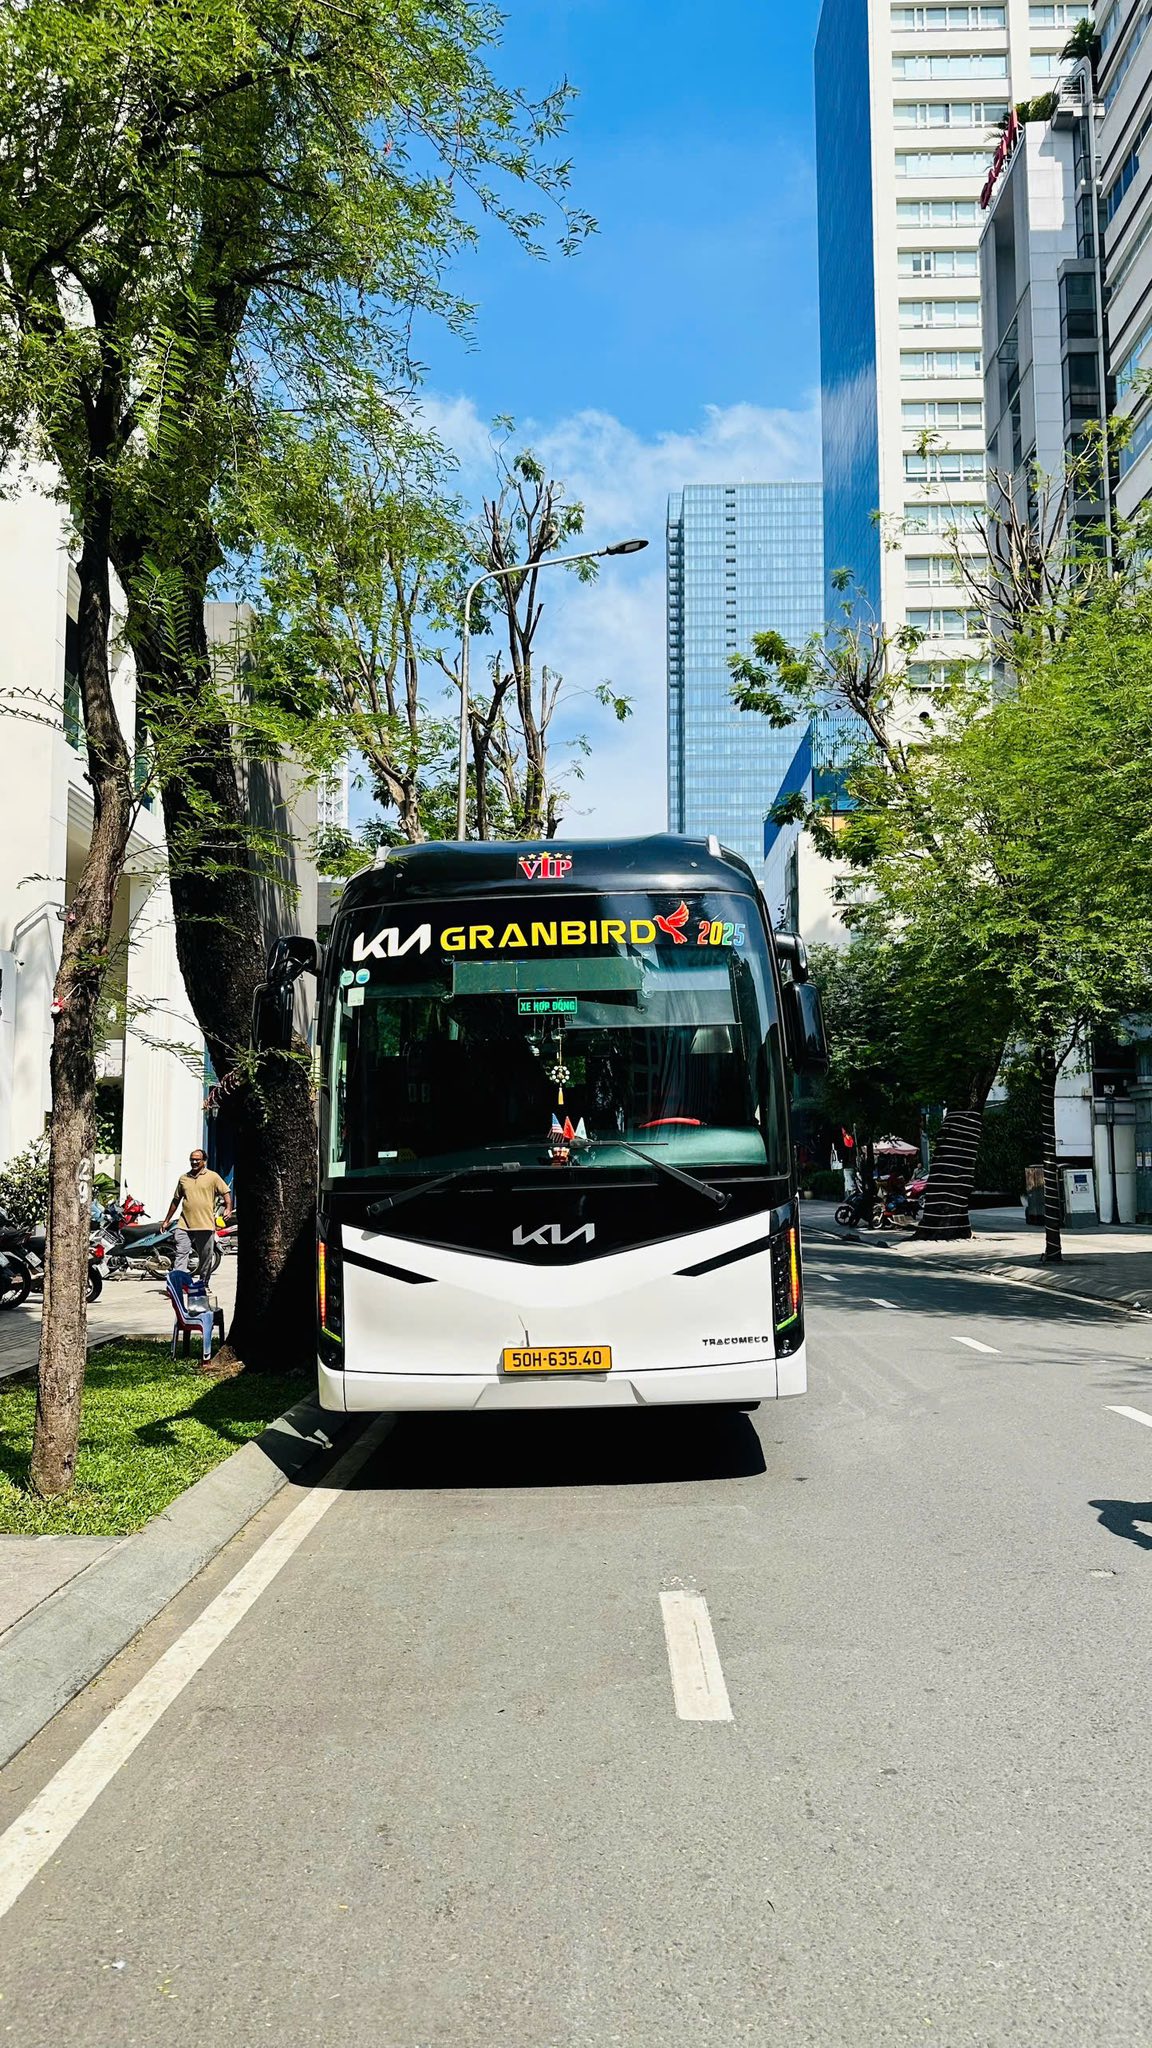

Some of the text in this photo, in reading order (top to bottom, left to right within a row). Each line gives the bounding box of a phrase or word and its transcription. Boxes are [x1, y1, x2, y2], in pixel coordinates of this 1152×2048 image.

[518, 855, 573, 879] VIP
[352, 919, 747, 962] KIA GRANBIRD 2025
[520, 1001, 532, 1012] XE
[512, 1223, 596, 1246] KIA
[702, 1335, 769, 1347] TRACOMECO
[512, 1350, 602, 1368] 50H-635.40
